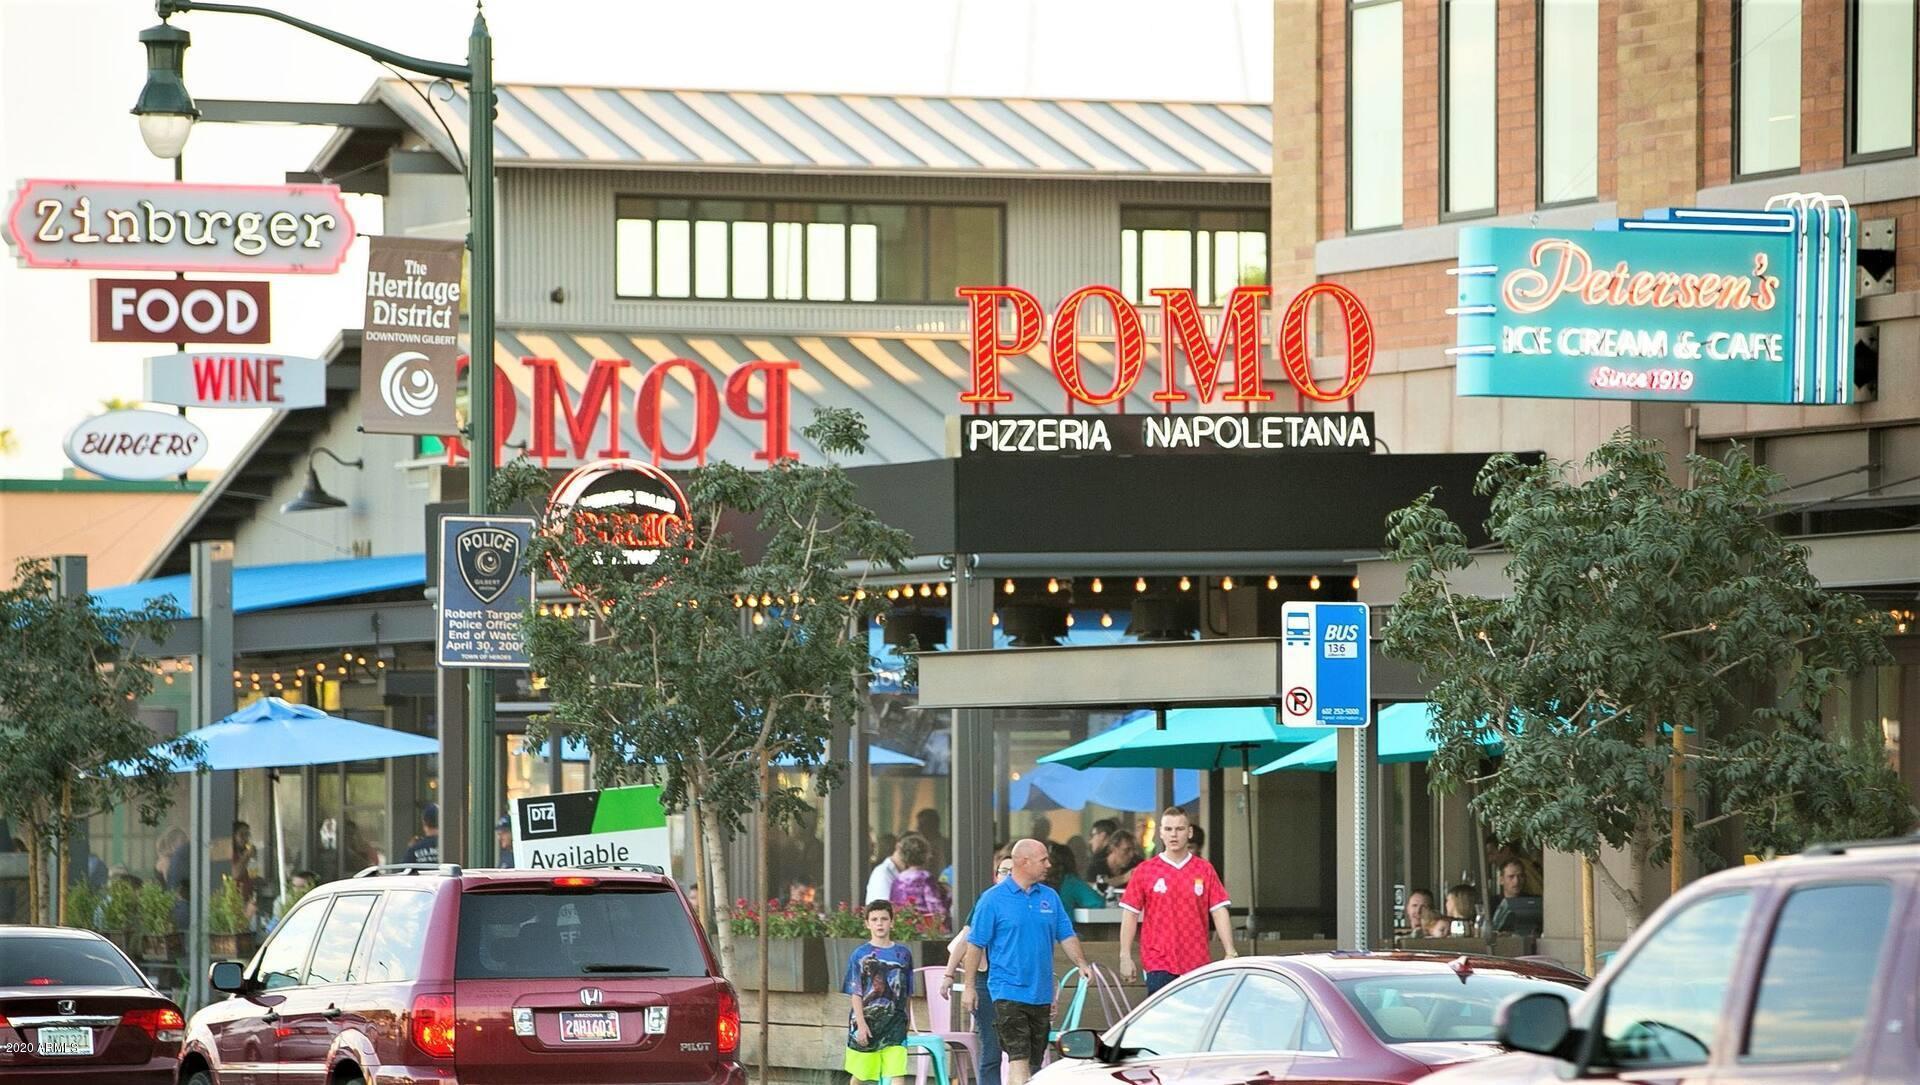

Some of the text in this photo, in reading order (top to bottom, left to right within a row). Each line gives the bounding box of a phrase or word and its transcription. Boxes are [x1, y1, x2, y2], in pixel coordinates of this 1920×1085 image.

[35, 197, 336, 256] Zinburger
[404, 259, 428, 276] The
[1502, 238, 1780, 314] Petersen's
[367, 271, 460, 306] Heritage
[111, 287, 259, 335] FOOD
[373, 300, 452, 329] District
[366, 331, 456, 345] DOWNTOWN GILBERT
[956, 282, 1375, 405] POMO
[1502, 326, 1784, 362] ICE CREAM & CAFE
[192, 356, 285, 403] WINE
[1592, 366, 1694, 391] Since 1919
[81, 431, 199, 457] BURGERS
[969, 415, 1371, 452] PIZZERIA NAPOLETANA
[462, 533, 514, 552] POLICE
[444, 609, 523, 621] Robert Targos
[449, 620, 522, 631] Police Offic
[448, 630, 470, 640] End
[473, 630, 486, 640] of
[1324, 624, 1359, 641] BUS
[446, 641, 473, 651] April
[476, 641, 494, 652] 30,
[1328, 643, 1346, 653] 136
[531, 807, 554, 821] DTZ
[530, 842, 629, 869] Available
[1153, 878, 1168, 894] 4
[680, 1042, 712, 1051] PILOT
